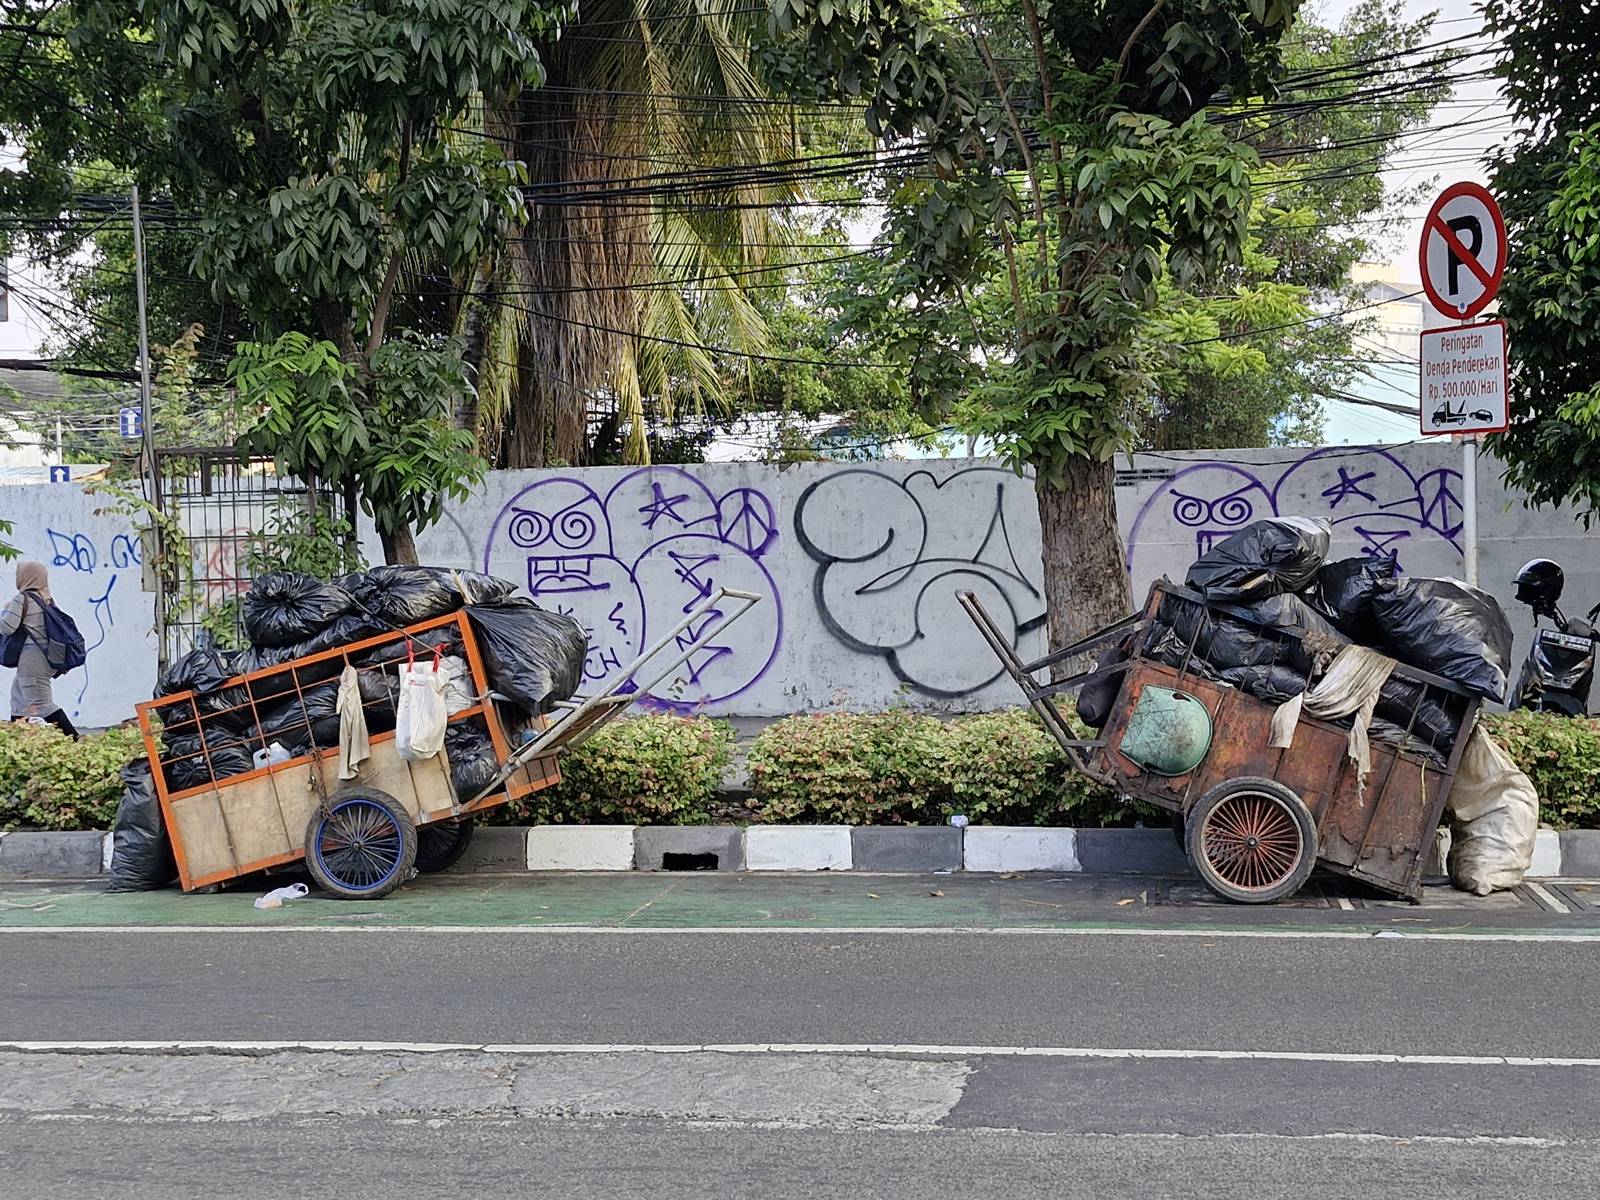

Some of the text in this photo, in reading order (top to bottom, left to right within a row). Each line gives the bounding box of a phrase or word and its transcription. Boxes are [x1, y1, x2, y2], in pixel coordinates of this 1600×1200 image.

[1447, 215, 1483, 296] P
[1441, 333, 1483, 354] Peringatan
[1426, 354, 1500, 378] Denda Penderekan
[1429, 376, 1498, 402] Rp. 500.000/Hari
